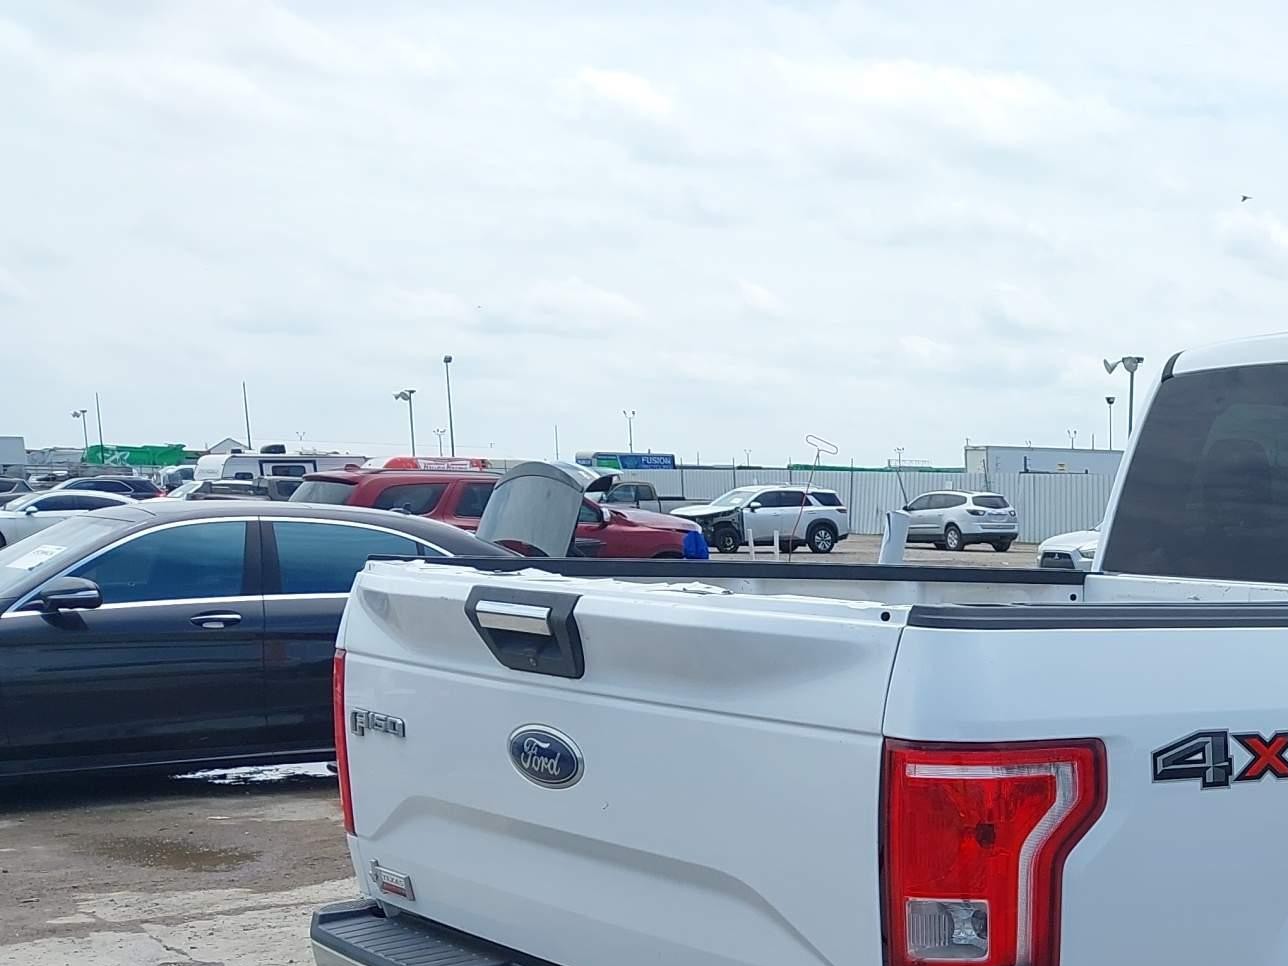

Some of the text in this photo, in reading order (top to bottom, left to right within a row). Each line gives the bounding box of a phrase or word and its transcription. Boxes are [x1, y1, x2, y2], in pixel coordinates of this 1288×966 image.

[641, 456, 672, 465] FUSION
[521, 737, 561, 776] Ford
[380, 871, 406, 888] TEXAS
